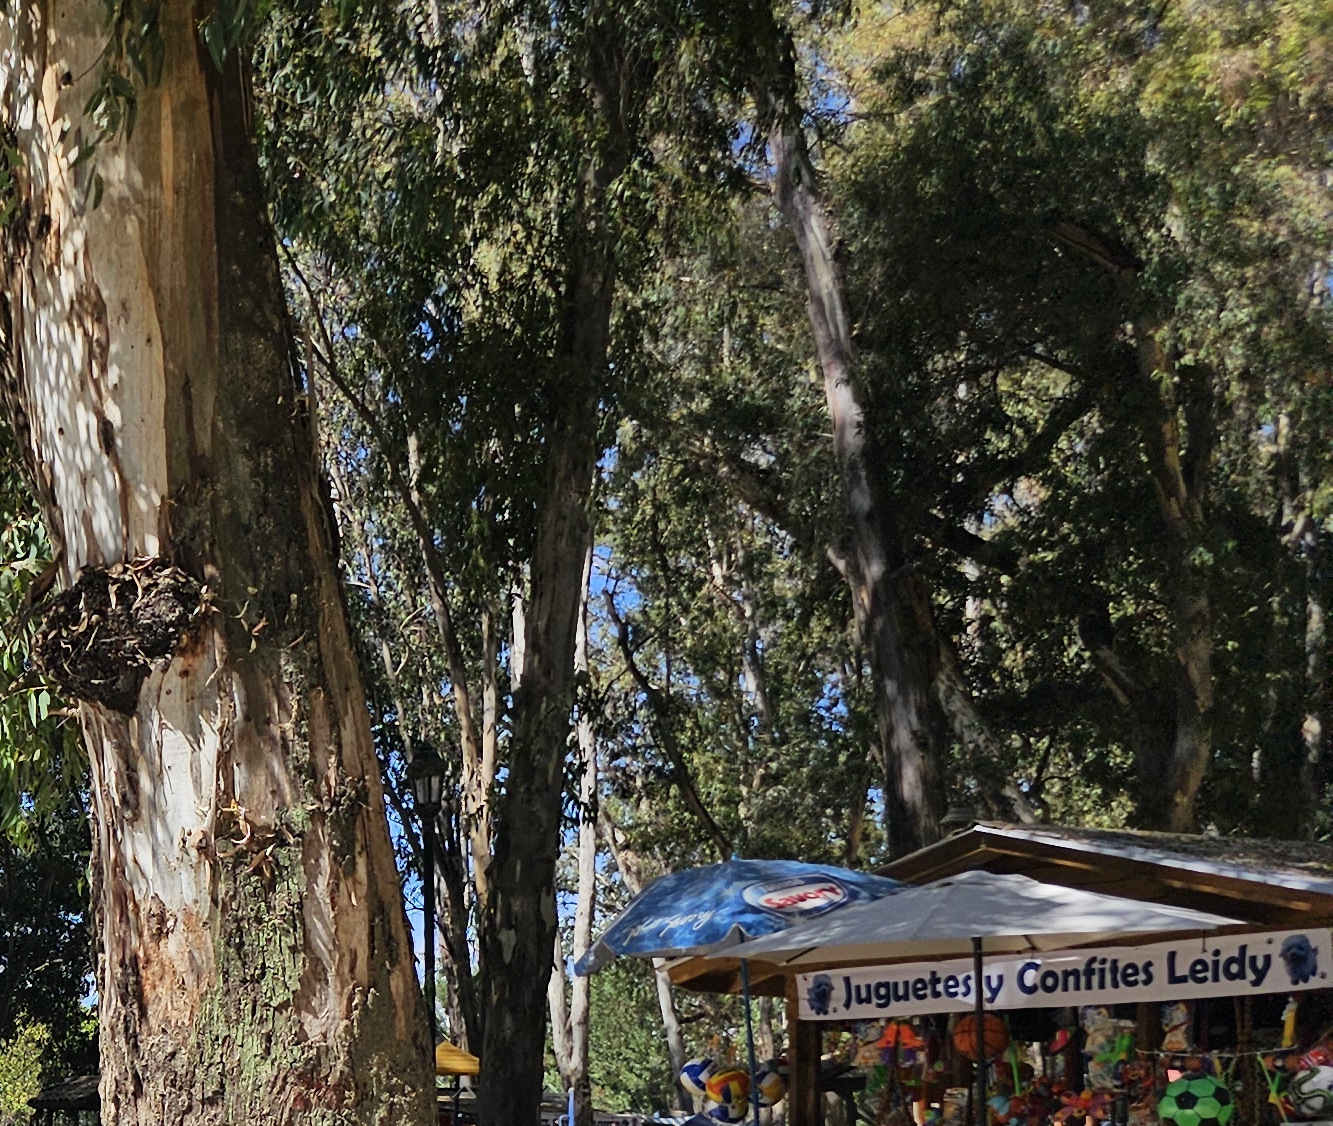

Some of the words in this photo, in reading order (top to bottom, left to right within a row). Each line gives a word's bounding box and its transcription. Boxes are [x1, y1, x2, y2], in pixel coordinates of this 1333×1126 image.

[763, 885, 841, 910] Savory
[842, 970, 972, 1011] Juguetes
[984, 974, 1004, 1004] y
[1017, 955, 1154, 996] Confites
[1166, 943, 1272, 988] Leidy
